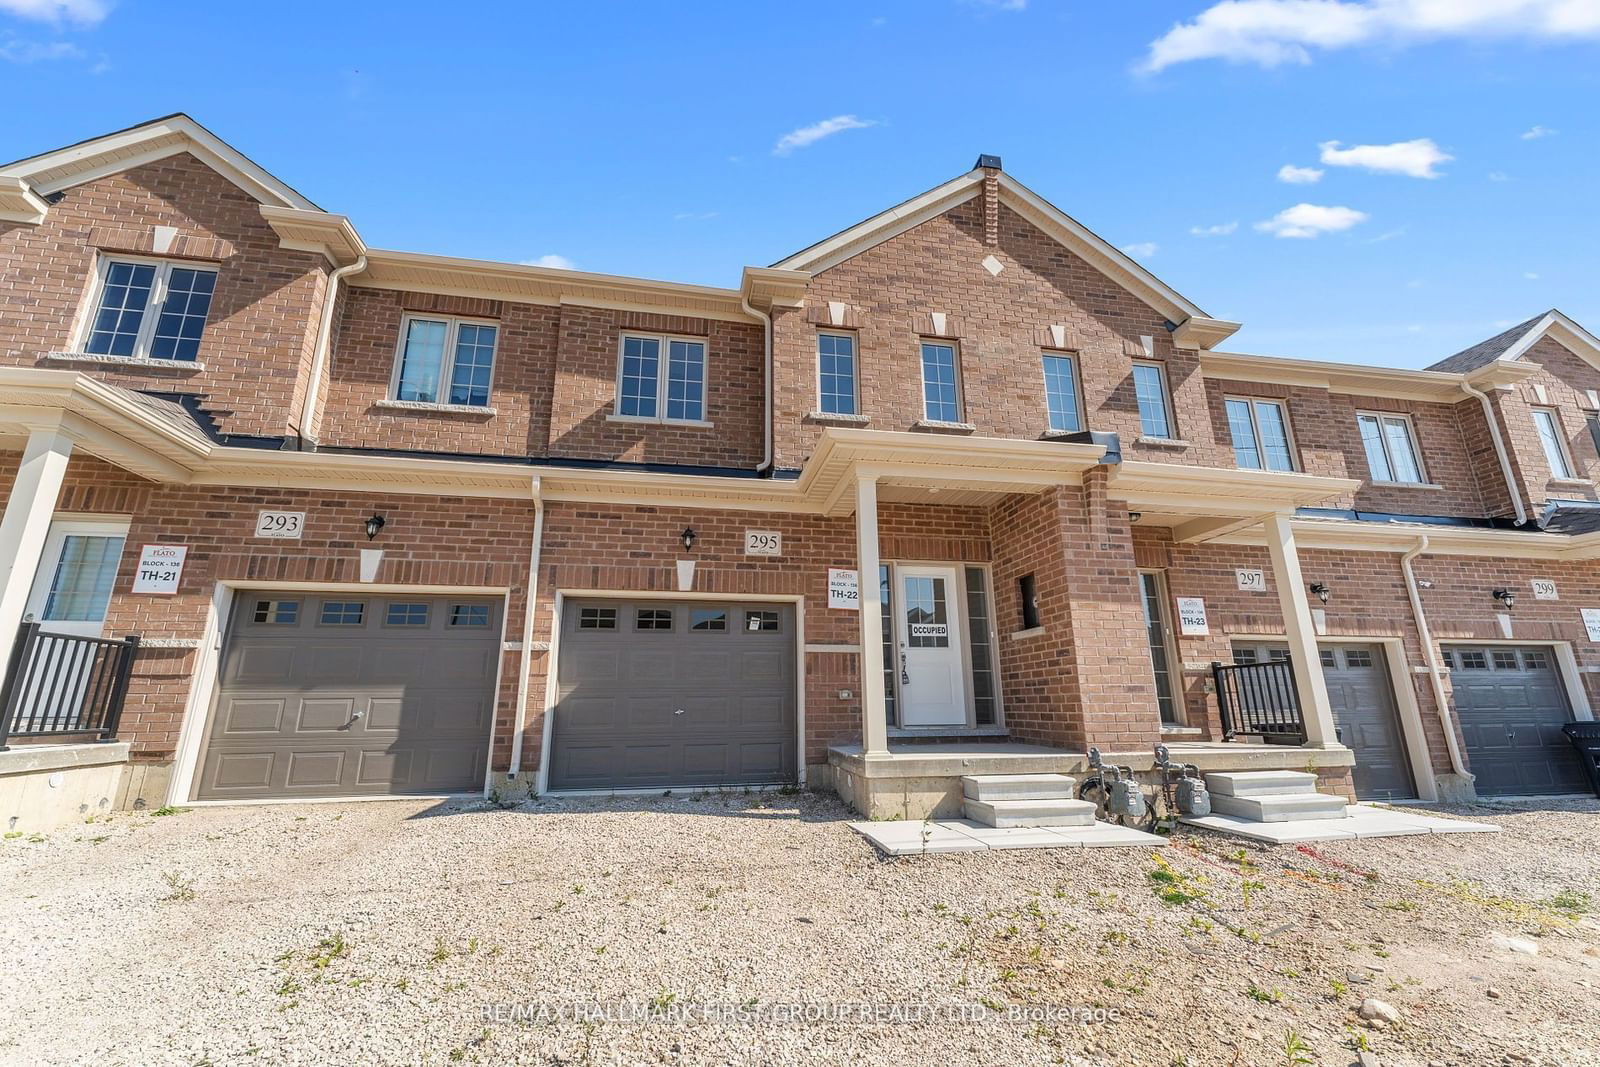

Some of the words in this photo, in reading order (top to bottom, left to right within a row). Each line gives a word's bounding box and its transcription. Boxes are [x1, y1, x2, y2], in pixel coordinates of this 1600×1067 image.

[261, 515, 298, 531] 293
[750, 534, 777, 549] 295
[140, 570, 176, 581] TH-21
[1239, 572, 1261, 585] 297
[1535, 582, 1554, 594] 299
[830, 589, 858, 599] TH-22
[1182, 617, 1206, 626] TH-23
[913, 626, 946, 634] OCCUPIED
